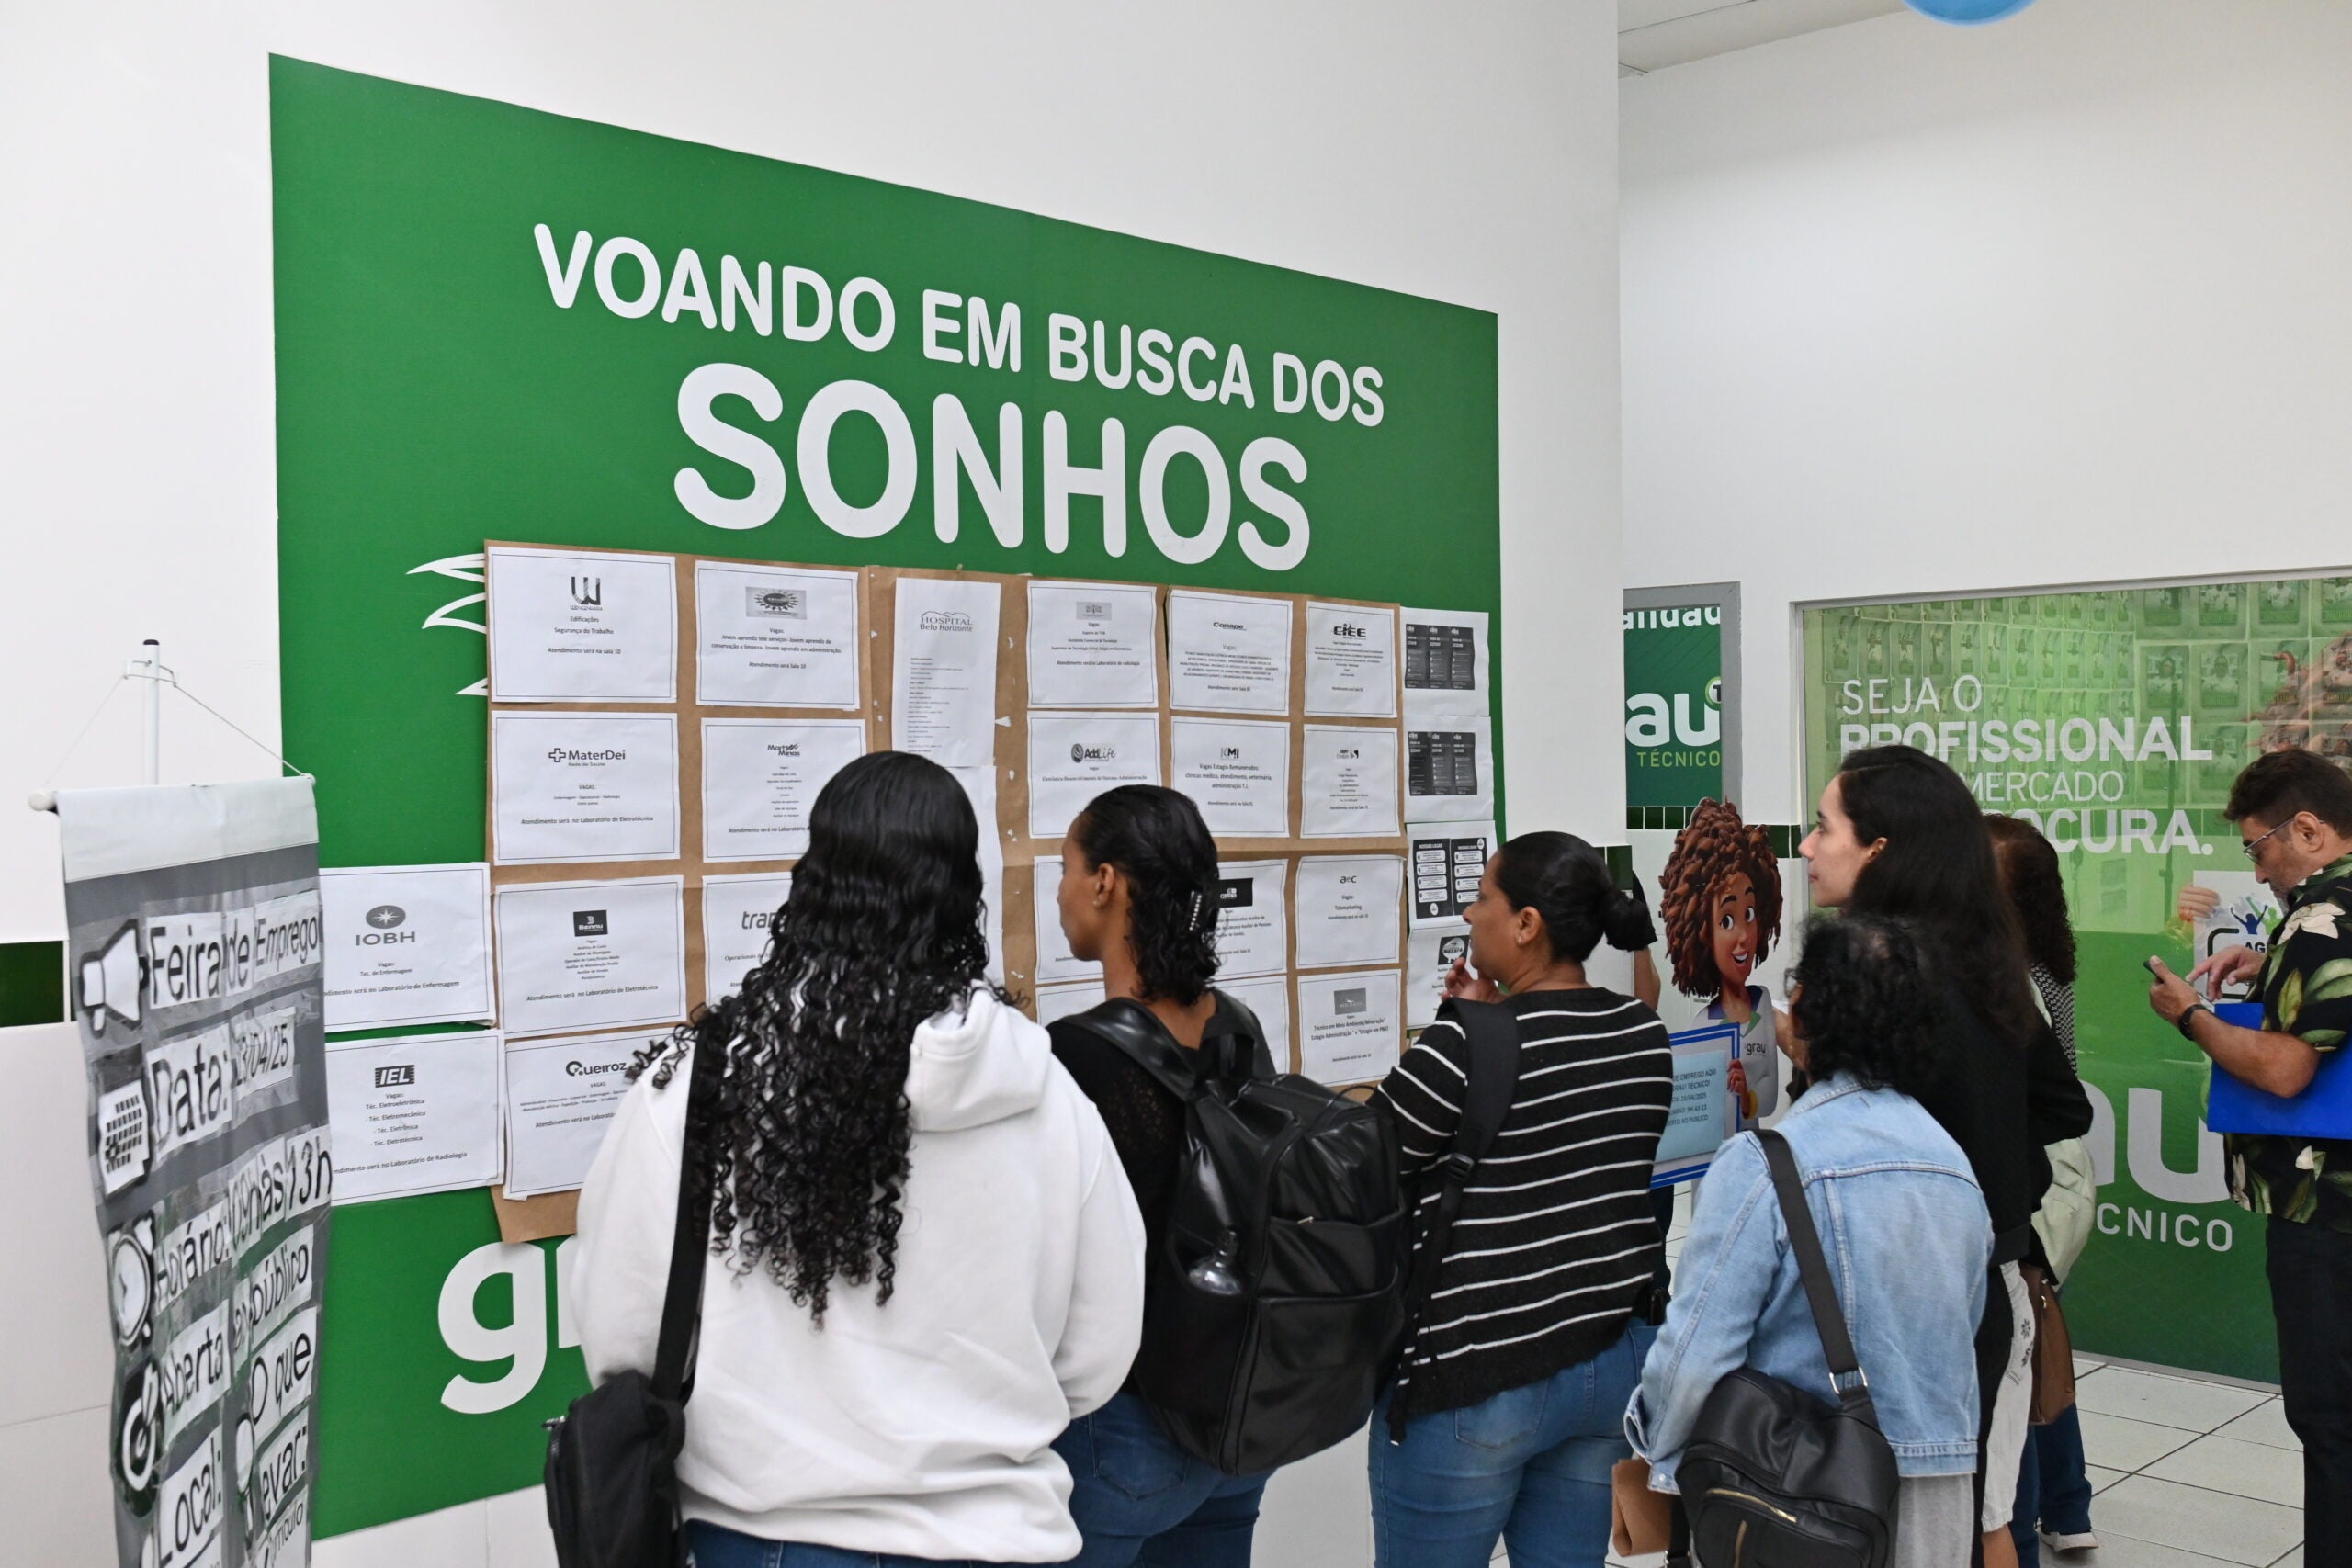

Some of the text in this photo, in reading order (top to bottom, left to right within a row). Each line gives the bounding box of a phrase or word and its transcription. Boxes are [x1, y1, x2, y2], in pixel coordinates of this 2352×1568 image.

[534, 223, 1384, 426] VOANDO EM BUSCA DOS
[674, 362, 1310, 571] SONHOS
[921, 616, 973, 625] HOSPITAL
[1842, 674, 1983, 716] SEJA O
[569, 750, 626, 761] MaterDei
[1637, 749, 1720, 767] TÉCNICO
[1962, 770, 2125, 803] MERCADO
[356, 931, 415, 946] IOBH
[149, 915, 318, 1004] Feira de Emprego
[380, 968, 412, 976] Enfermagem
[379, 984, 413, 993] Laboratório
[586, 988, 616, 997] Laboratório
[1747, 1043, 1766, 1055] grau
[379, 1067, 410, 1086] IEL
[566, 1061, 627, 1077] Queiroz
[1680, 1071, 1704, 1080] EMPREGO
[151, 1043, 228, 1145] Data:
[379, 1099, 424, 1109] Eletroeletrônica
[382, 1111, 426, 1121] Eletromecânica
[536, 1119, 570, 1128] Atendimento
[387, 1135, 423, 1145] Eletrotécnica
[390, 1158, 425, 1168] Laboratório
[435, 1153, 467, 1161] Radiologia
[287, 1135, 333, 1209] 13h
[2096, 1202, 2233, 1252] CNICO
[251, 1244, 308, 1333] público
[251, 1332, 311, 1425] O que
[261, 1425, 307, 1521] evar:
